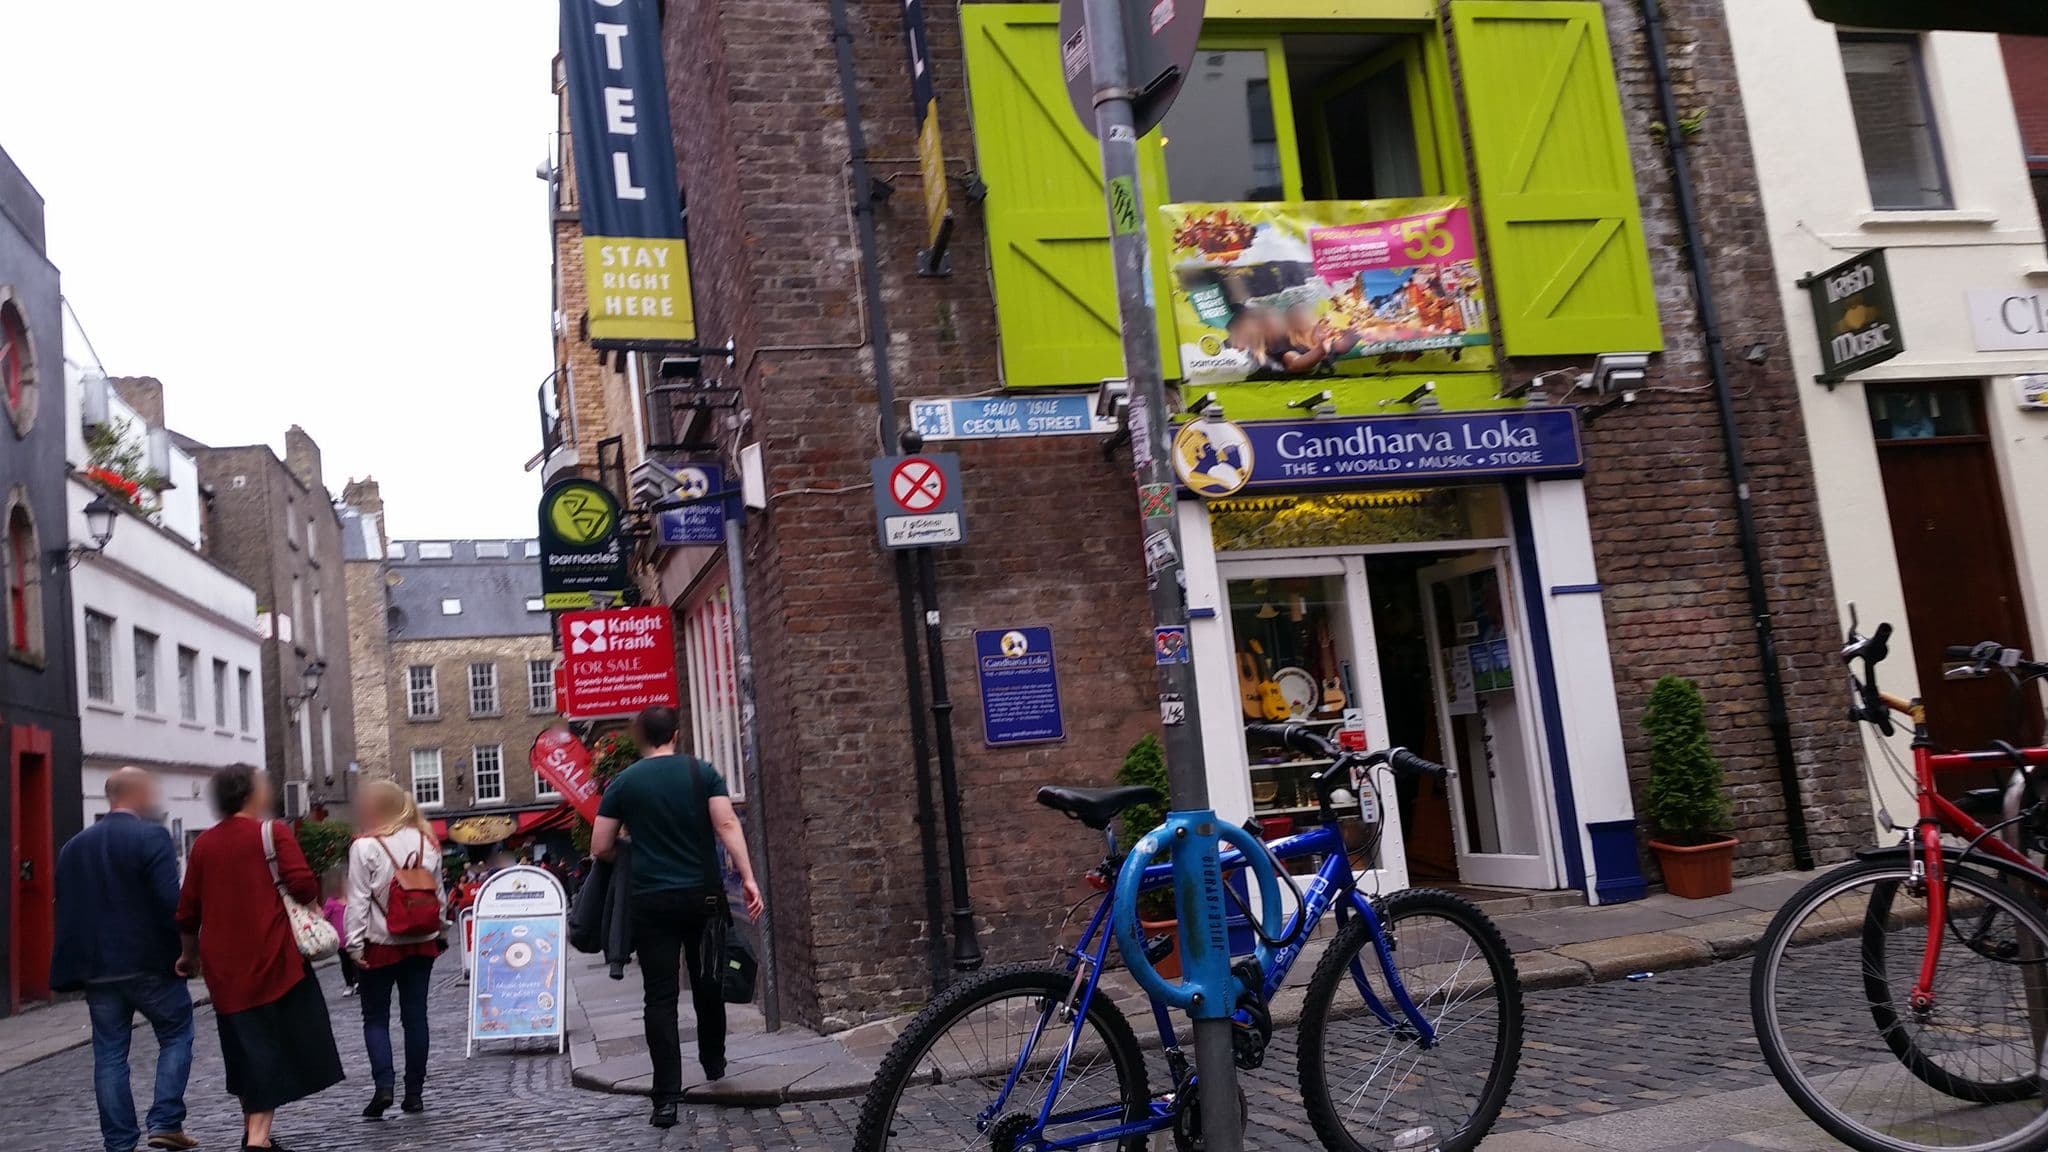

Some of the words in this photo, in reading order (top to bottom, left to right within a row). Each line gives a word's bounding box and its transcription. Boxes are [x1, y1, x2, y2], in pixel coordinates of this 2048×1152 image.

[594, 0, 646, 200] TEL
[600, 245, 669, 268] STAY
[602, 271, 671, 291] RIGHT
[1825, 263, 1875, 304] Irish
[604, 295, 673, 317] HERE
[2001, 294, 2048, 335] Cl
[1830, 322, 1894, 364] Music
[962, 417, 1022, 434] CECILIA
[1028, 415, 1083, 431] STREET
[1276, 425, 1453, 460] Gandharva
[1463, 418, 1539, 450] Loka
[1281, 462, 1318, 477] THE
[1336, 459, 1400, 473] WORLD
[1418, 454, 1472, 469] MUSIC
[1489, 450, 1544, 465] STORE
[548, 552, 619, 566] barnacles
[607, 614, 663, 636] Knight
[609, 633, 656, 651] Frank
[573, 660, 603, 677] FOR
[606, 657, 643, 673] SALE
[546, 747, 599, 803] SALE
[1202, 855, 1220, 902] STUDIO
[1208, 913, 1225, 951] JUICE
